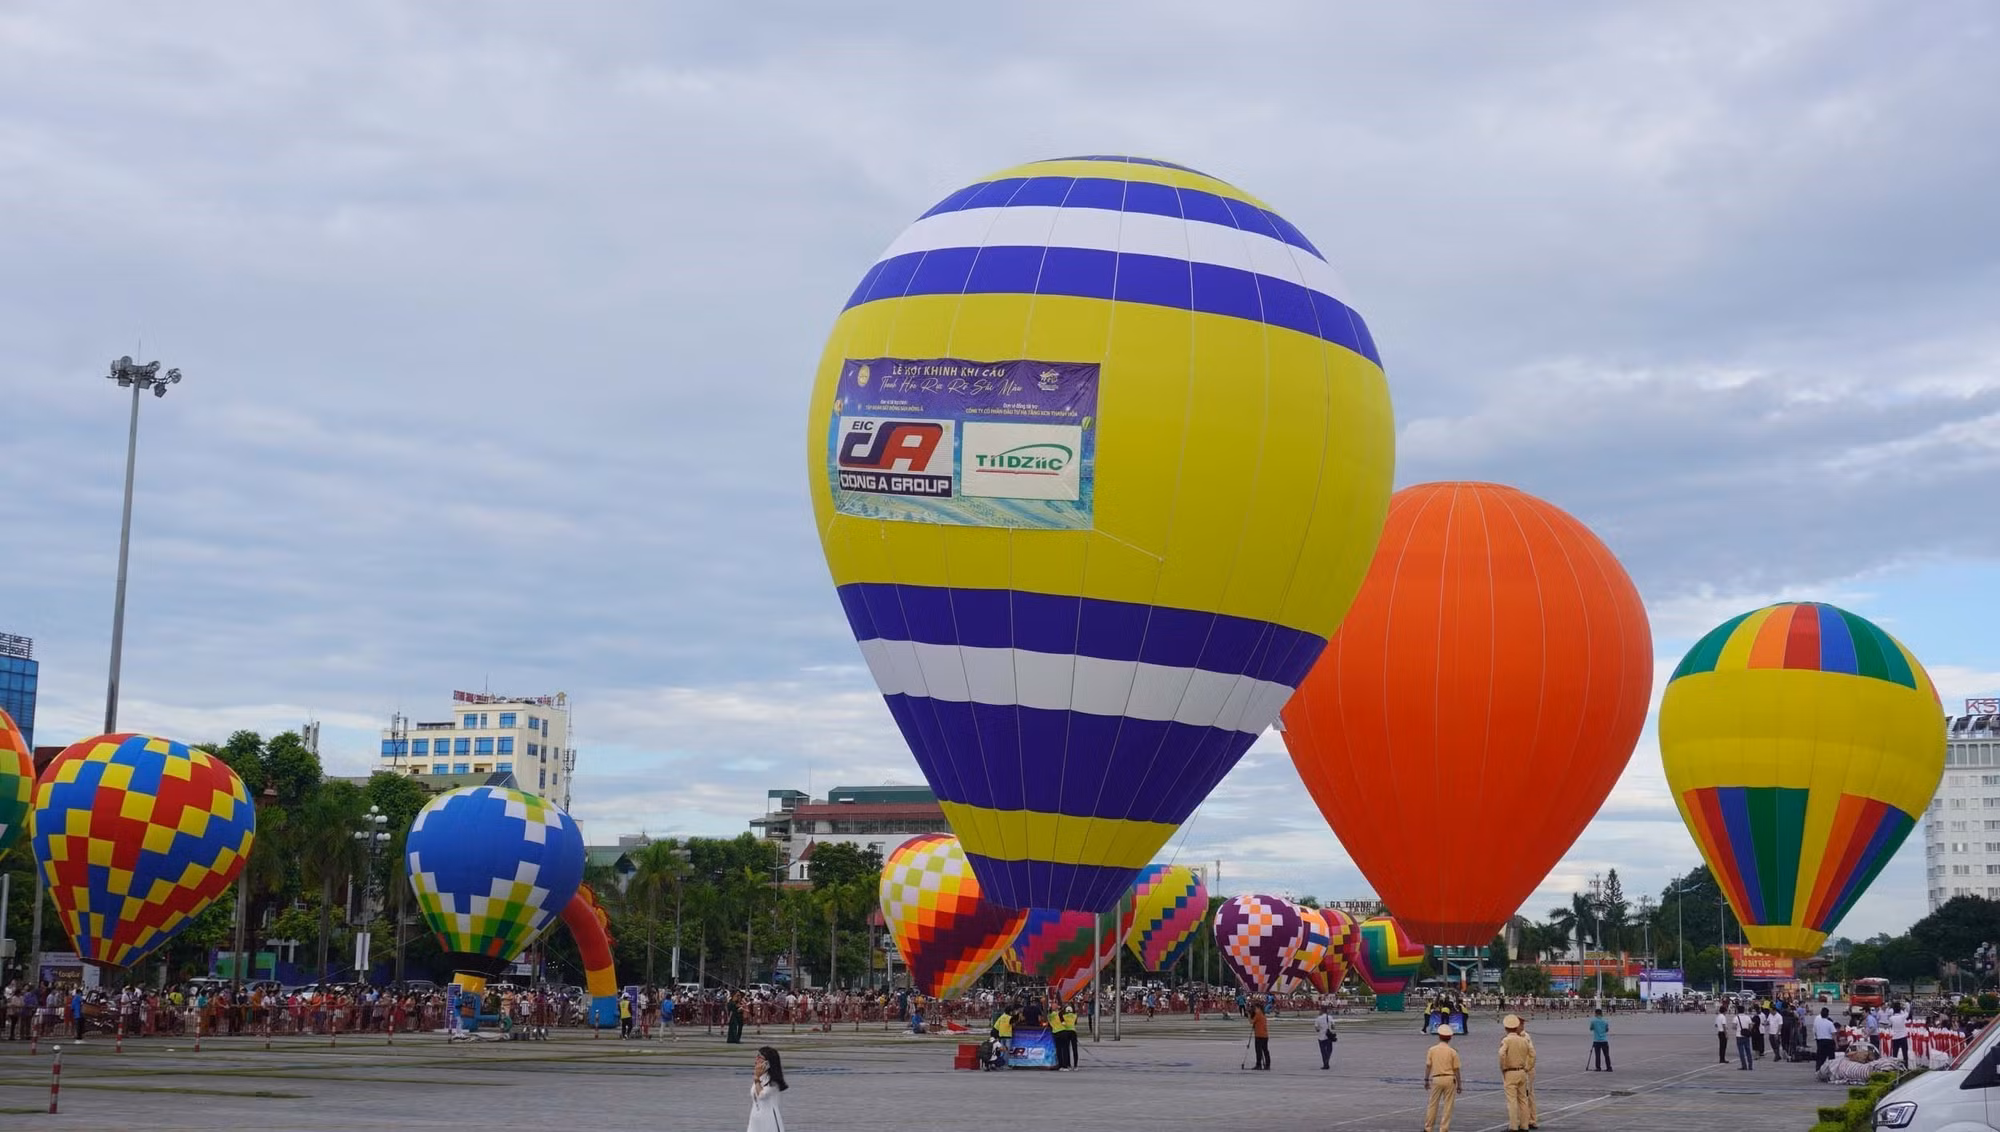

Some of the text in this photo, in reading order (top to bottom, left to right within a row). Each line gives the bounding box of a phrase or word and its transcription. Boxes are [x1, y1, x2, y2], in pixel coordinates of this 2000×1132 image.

[923, 366, 957, 376] KHINH
[852, 420, 874, 431] EIC
[878, 476, 888, 490] A
[891, 477, 949, 493] GROUP
